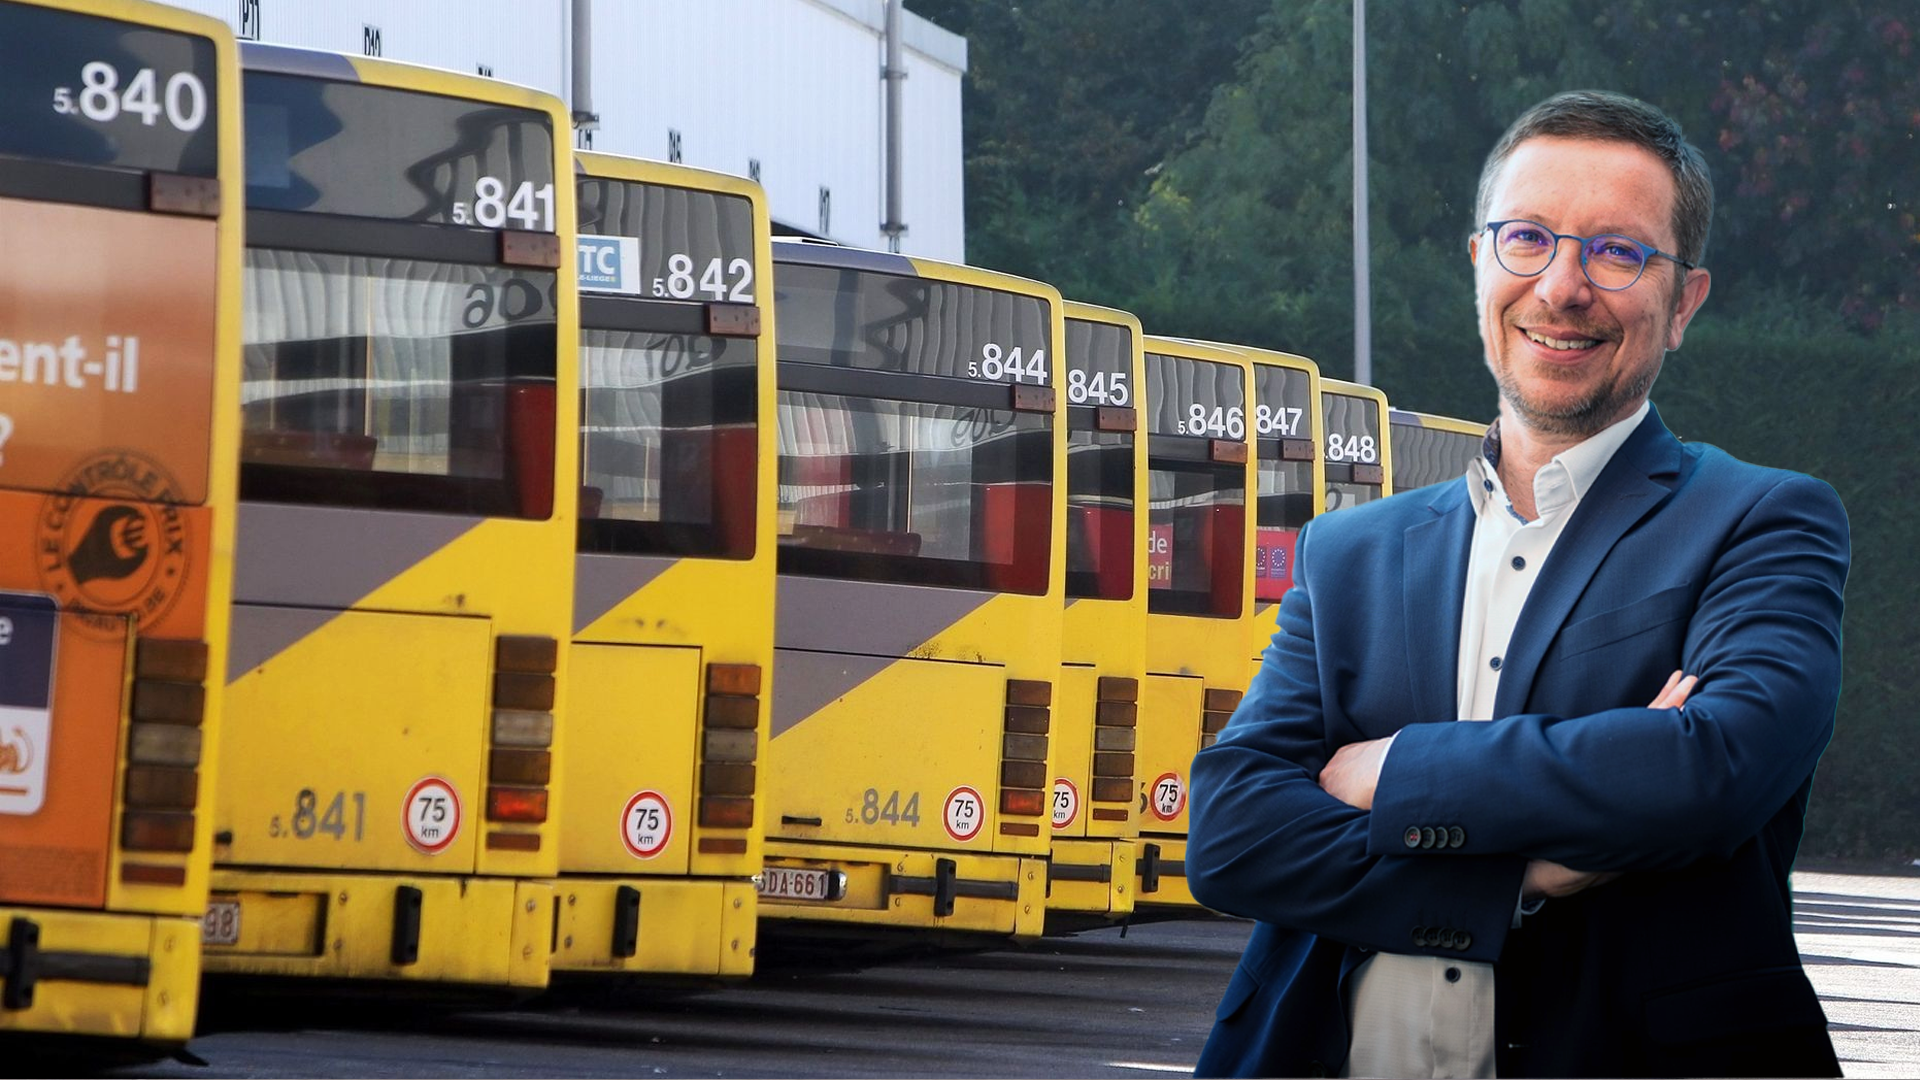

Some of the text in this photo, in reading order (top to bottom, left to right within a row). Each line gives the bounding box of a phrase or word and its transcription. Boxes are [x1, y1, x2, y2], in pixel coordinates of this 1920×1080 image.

[52, 61, 207, 131] 5.840
[452, 176, 554, 232] 5.841
[652, 253, 754, 303] 5.842
[967, 343, 1048, 386] 5.844
[1068, 369, 1129, 406] 845
[1177, 404, 1244, 439] 5.846
[1256, 405, 1303, 436] 847
[1053, 791, 1069, 808] 75
[1159, 783, 1178, 803] 75
[418, 797, 446, 823] 75
[635, 808, 659, 831] 75
[844, 788, 920, 827] 5.844
[953, 799, 974, 819] 75
[1053, 809, 1066, 819] km
[1161, 803, 1173, 813] km
[420, 825, 439, 839] km
[955, 819, 970, 830] km
[637, 833, 654, 845] km
